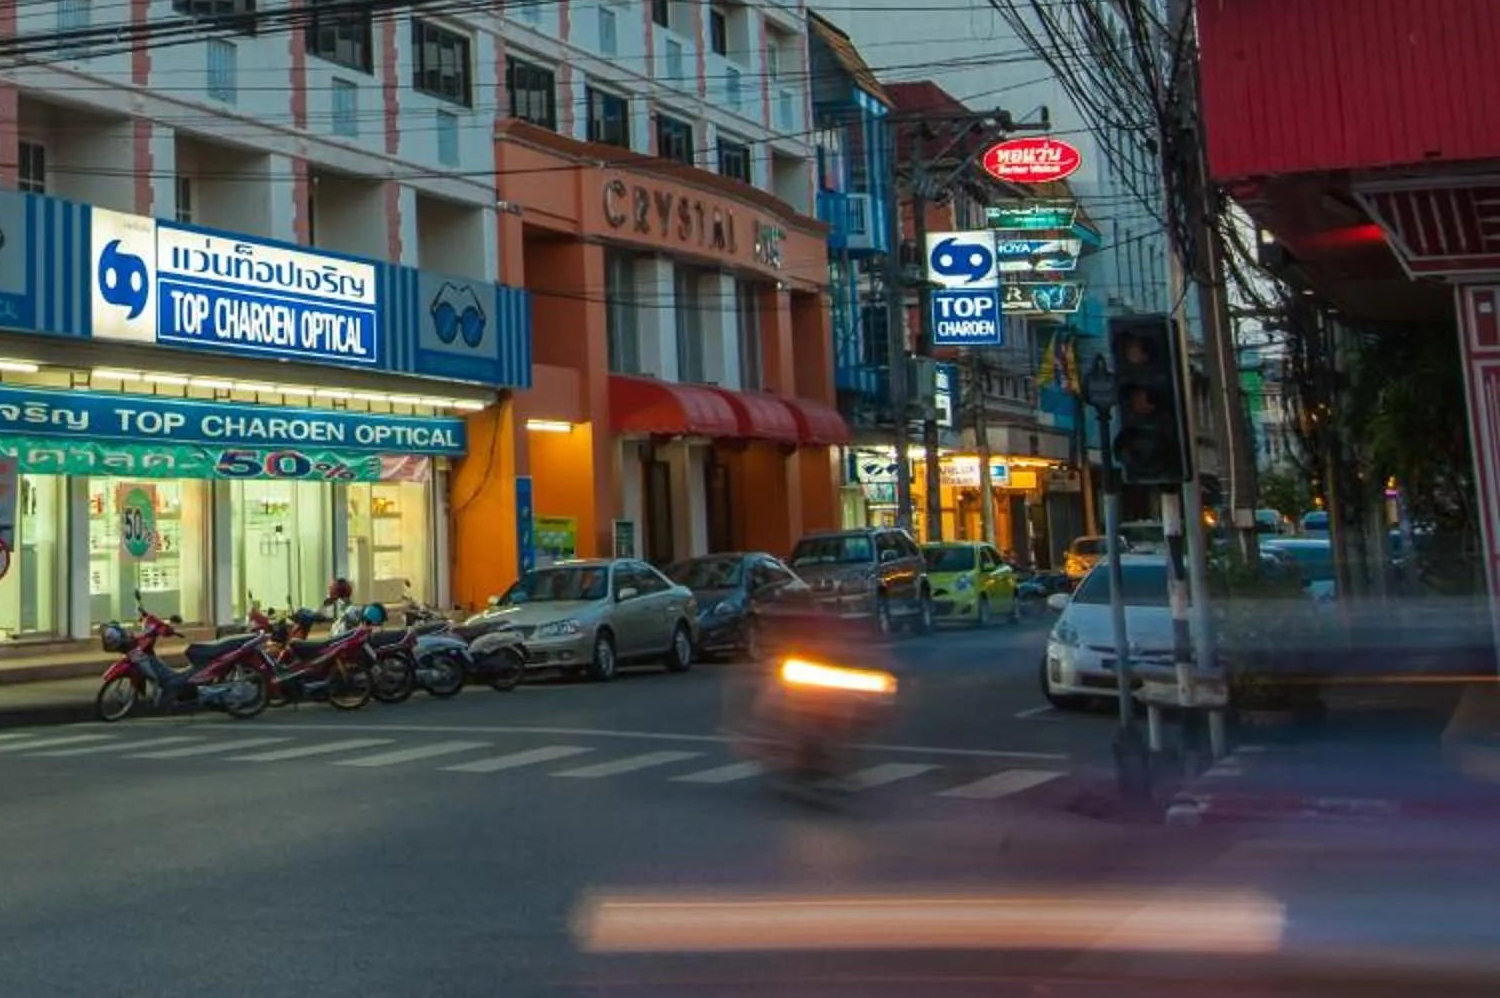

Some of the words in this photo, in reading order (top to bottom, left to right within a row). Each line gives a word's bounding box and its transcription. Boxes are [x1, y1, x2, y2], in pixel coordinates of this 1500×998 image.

[172, 238, 366, 299] แว่นท็อปเจริญ
[170, 289, 210, 335] TOP
[214, 296, 297, 346] CHAROEN
[301, 309, 368, 355] OPTICAL
[936, 296, 993, 318] TOP
[937, 321, 996, 337] CHAROEN
[114, 409, 186, 435] TOP
[200, 415, 346, 442] CHAROEN
[354, 425, 461, 448] OPTICAL
[213, 450, 357, 480] 50%
